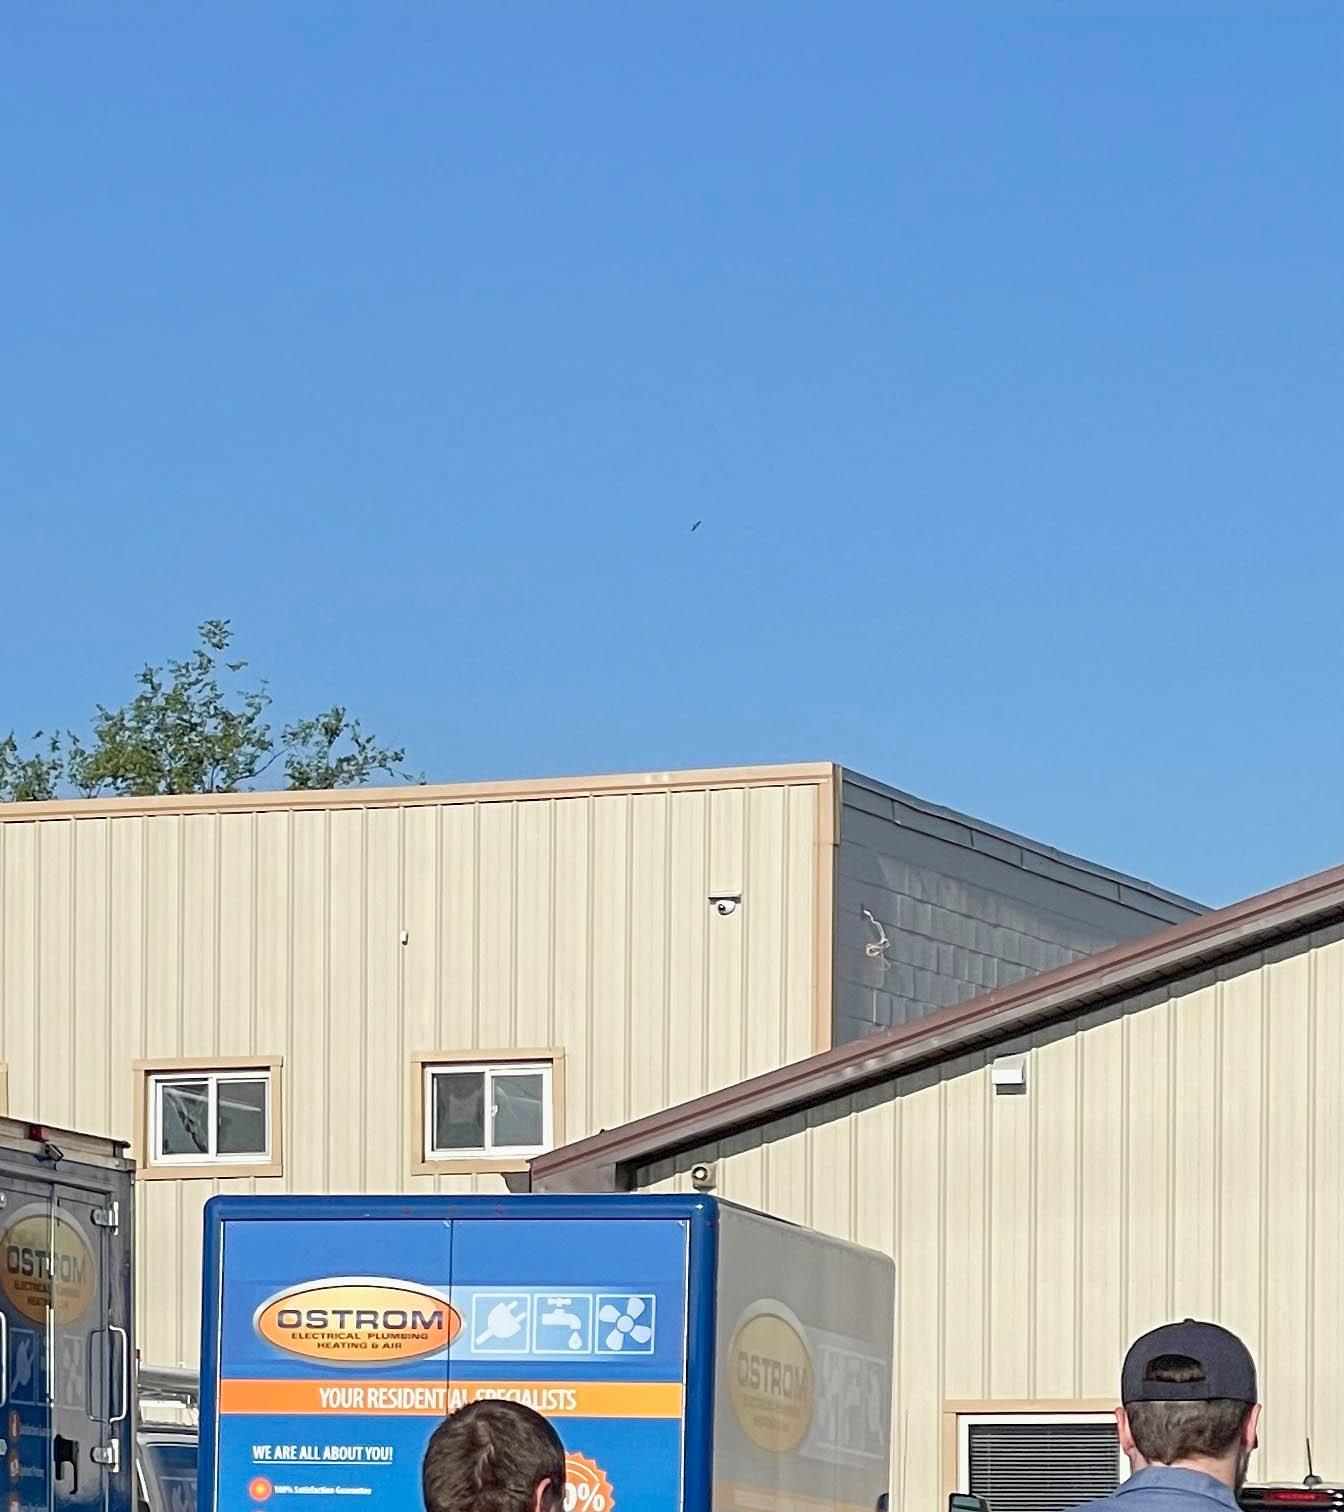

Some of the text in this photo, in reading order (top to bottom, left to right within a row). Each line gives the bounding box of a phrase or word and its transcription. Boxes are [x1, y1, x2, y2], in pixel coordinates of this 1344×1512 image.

[278, 1309, 444, 1330] OSTROM
[291, 1332, 429, 1340] ELECTRICAL PLUMBING
[317, 1342, 368, 1350] HEATING
[381, 1342, 402, 1350] AIR
[319, 1386, 364, 1409] YOUR
[252, 1445, 393, 1461] WE ARE ALL ABOUT YOU!
[563, 1482, 606, 1512] 0%
